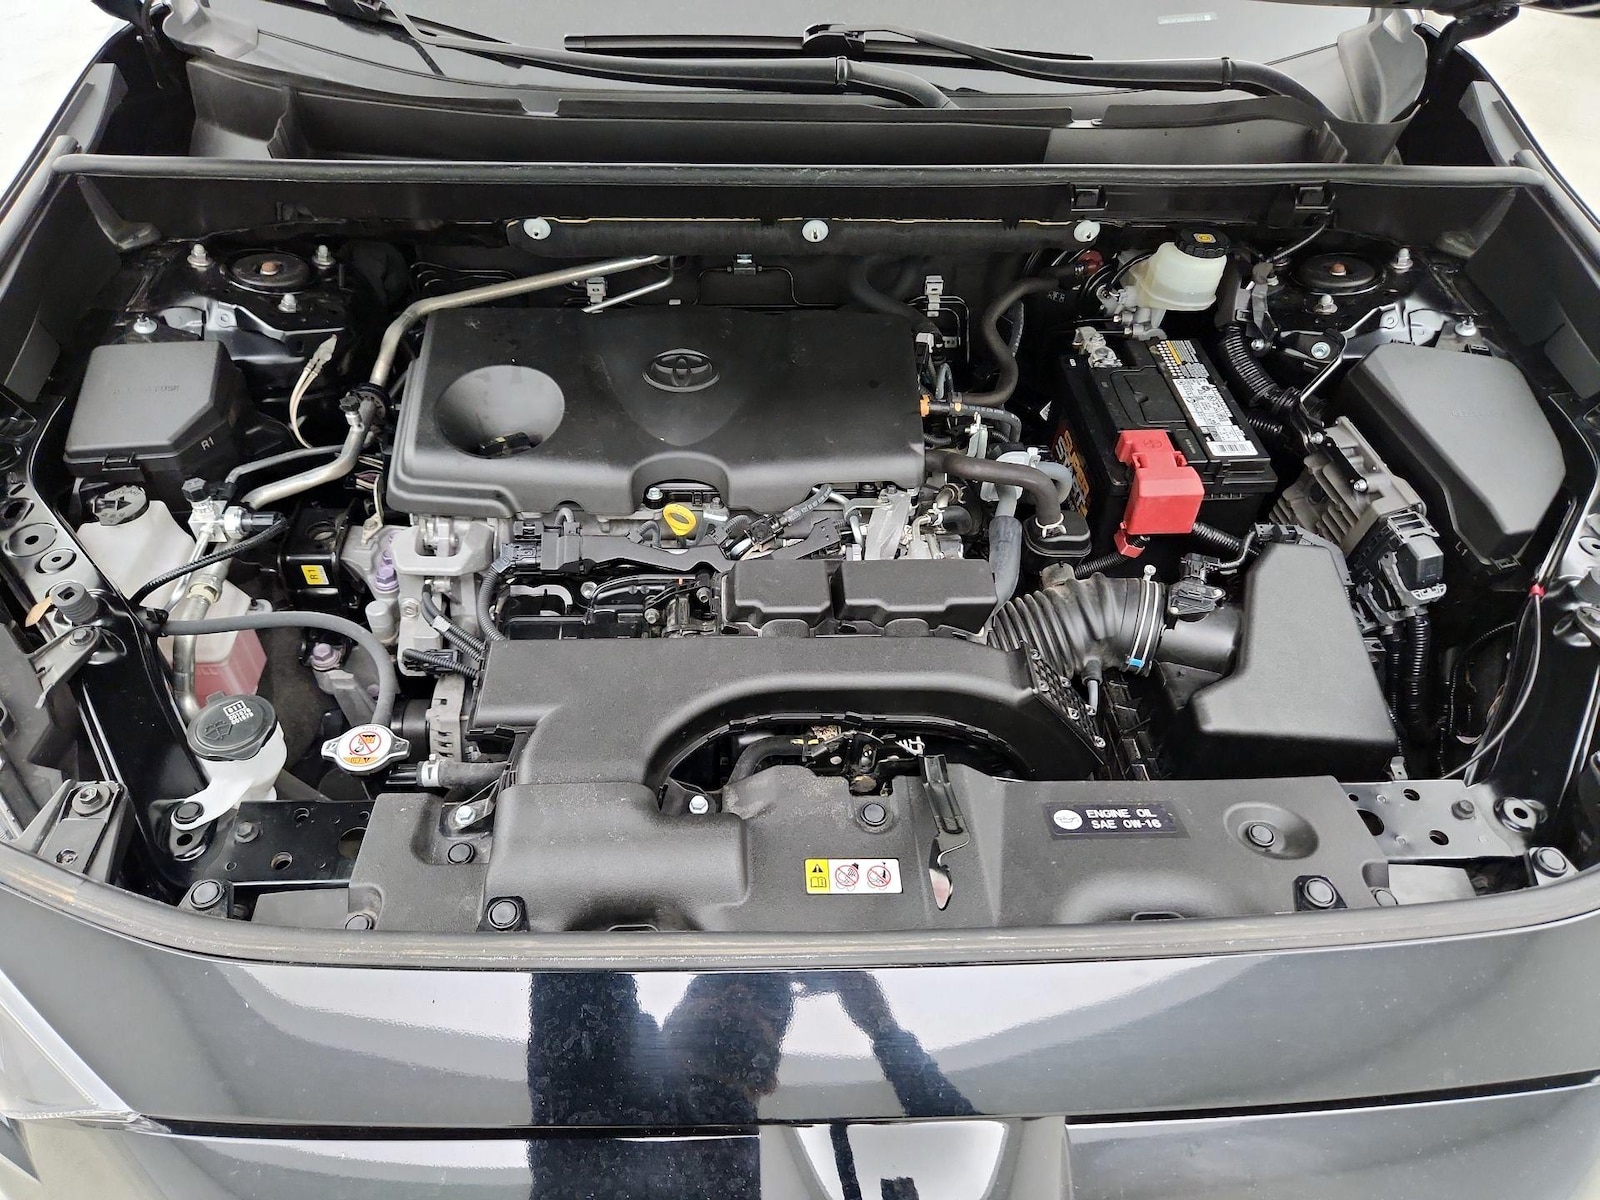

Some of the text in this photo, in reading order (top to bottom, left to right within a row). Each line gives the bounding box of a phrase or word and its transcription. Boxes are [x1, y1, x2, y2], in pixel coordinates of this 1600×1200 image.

[201, 436, 215, 450] R1
[1455, 541, 1468, 556] L1
[1086, 808, 1157, 819] ENGINE OIL
[1091, 819, 1162, 829] SAE 0W-16
